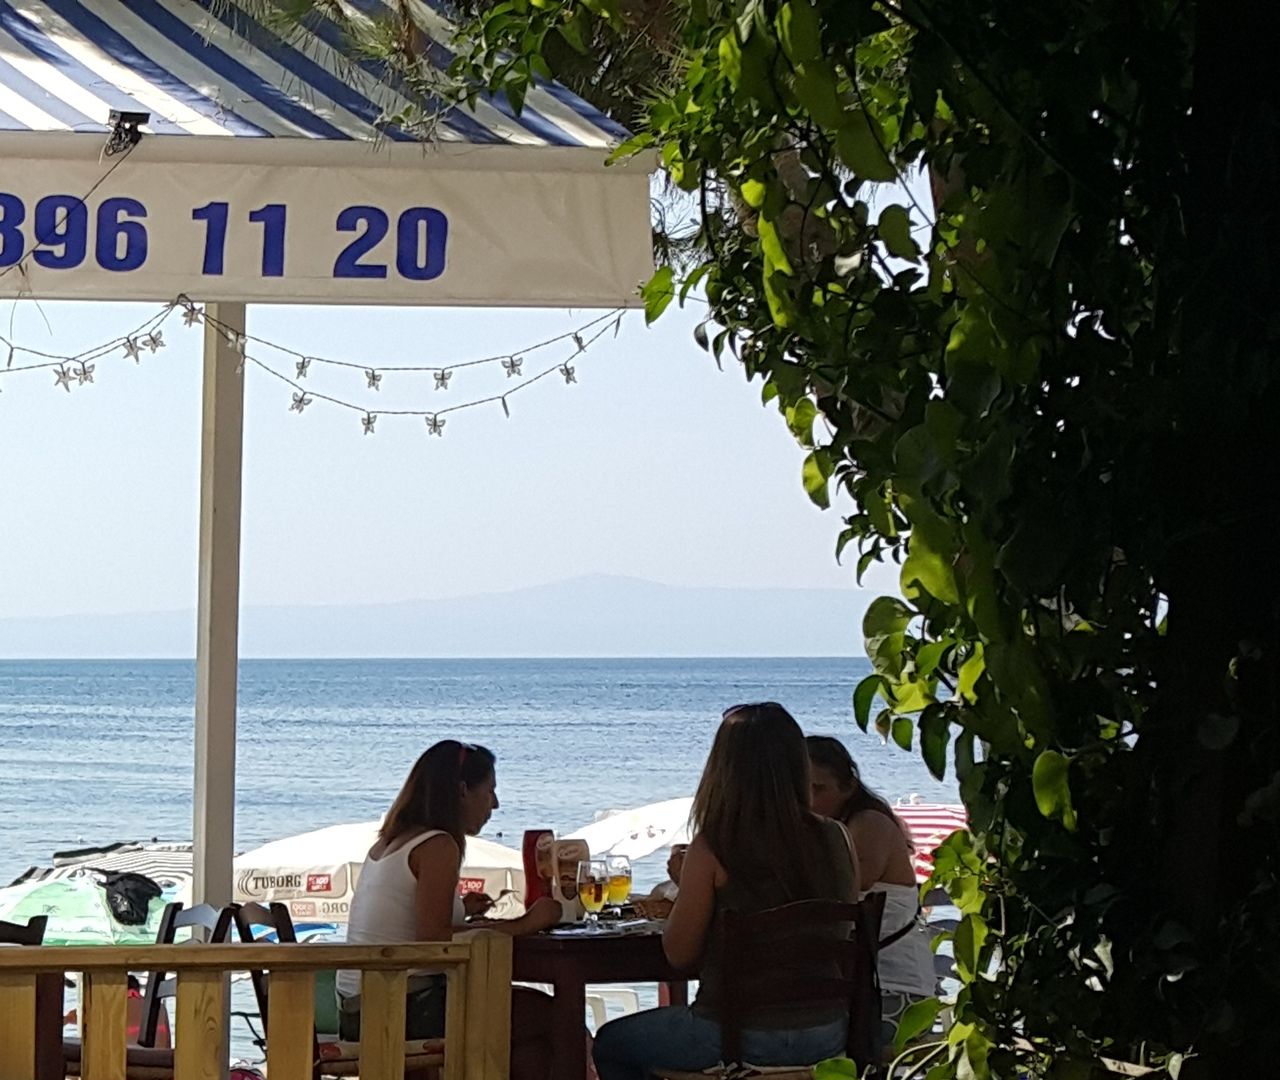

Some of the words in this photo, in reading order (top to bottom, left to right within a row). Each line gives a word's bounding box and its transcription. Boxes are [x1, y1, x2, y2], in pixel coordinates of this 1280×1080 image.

[190, 204, 286, 277] 11
[335, 207, 449, 281] 20
[252, 874, 302, 890] TUBORG
